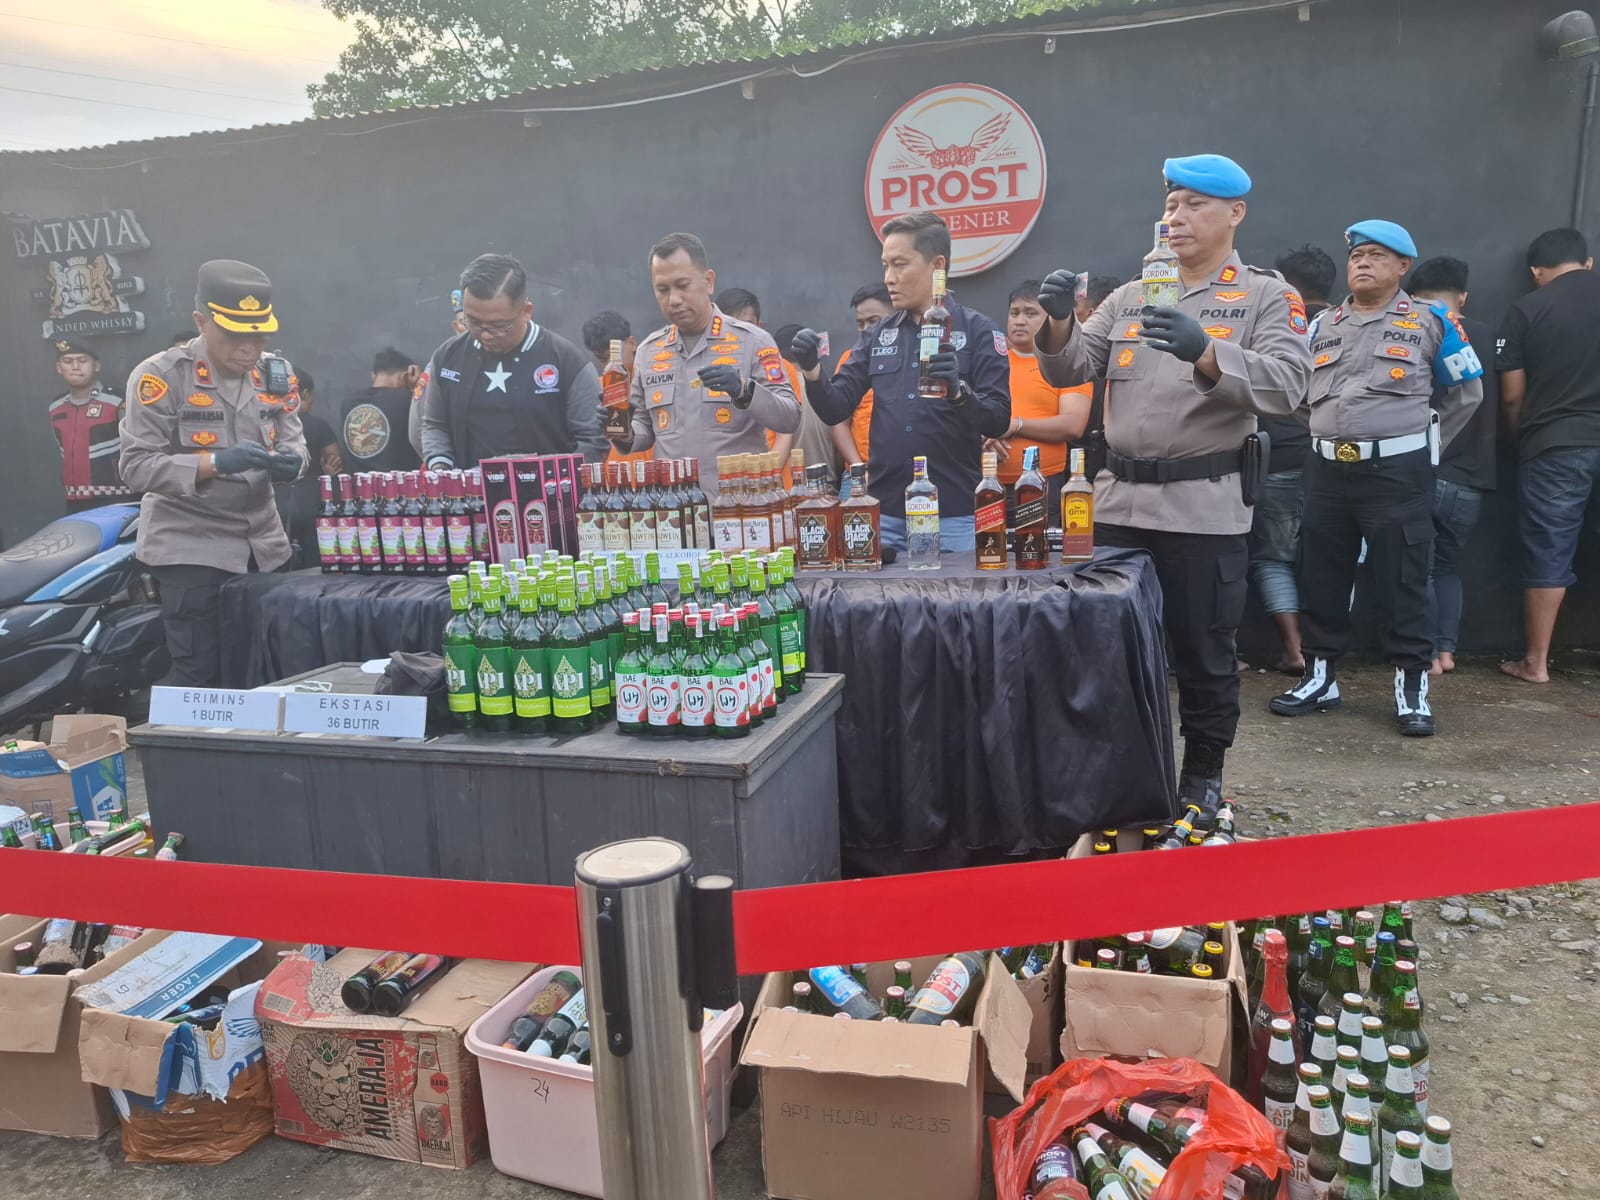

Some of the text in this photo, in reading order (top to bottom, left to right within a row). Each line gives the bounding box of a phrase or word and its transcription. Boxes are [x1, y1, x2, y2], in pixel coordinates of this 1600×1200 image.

[880, 162, 1028, 212] PROST
[950, 210, 1011, 231] ENER
[12, 214, 137, 257] BATAVIA
[1200, 308, 1247, 318] POLRI
[1383, 330, 1422, 345] POLRI
[800, 526, 826, 543] BLACK
[844, 524, 871, 541] BLACK
[848, 533, 869, 550] JACK
[804, 533, 825, 551] JACK
[447, 669, 466, 687] PI
[477, 671, 504, 689] API
[514, 672, 543, 690] API
[552, 672, 584, 690] API
[623, 674, 637, 682] BAE
[651, 677, 665, 685] BAE
[719, 678, 734, 686] BAE
[319, 697, 390, 713] EKSTASI
[191, 709, 233, 722] 1 BUTIR
[327, 717, 379, 730] 36 BUTIR
[161, 972, 201, 1000] LAGER
[356, 1038, 393, 1140] AMERAJA
[530, 1077, 551, 1103] 24
[781, 1102, 952, 1134] API HIJAU W2135
